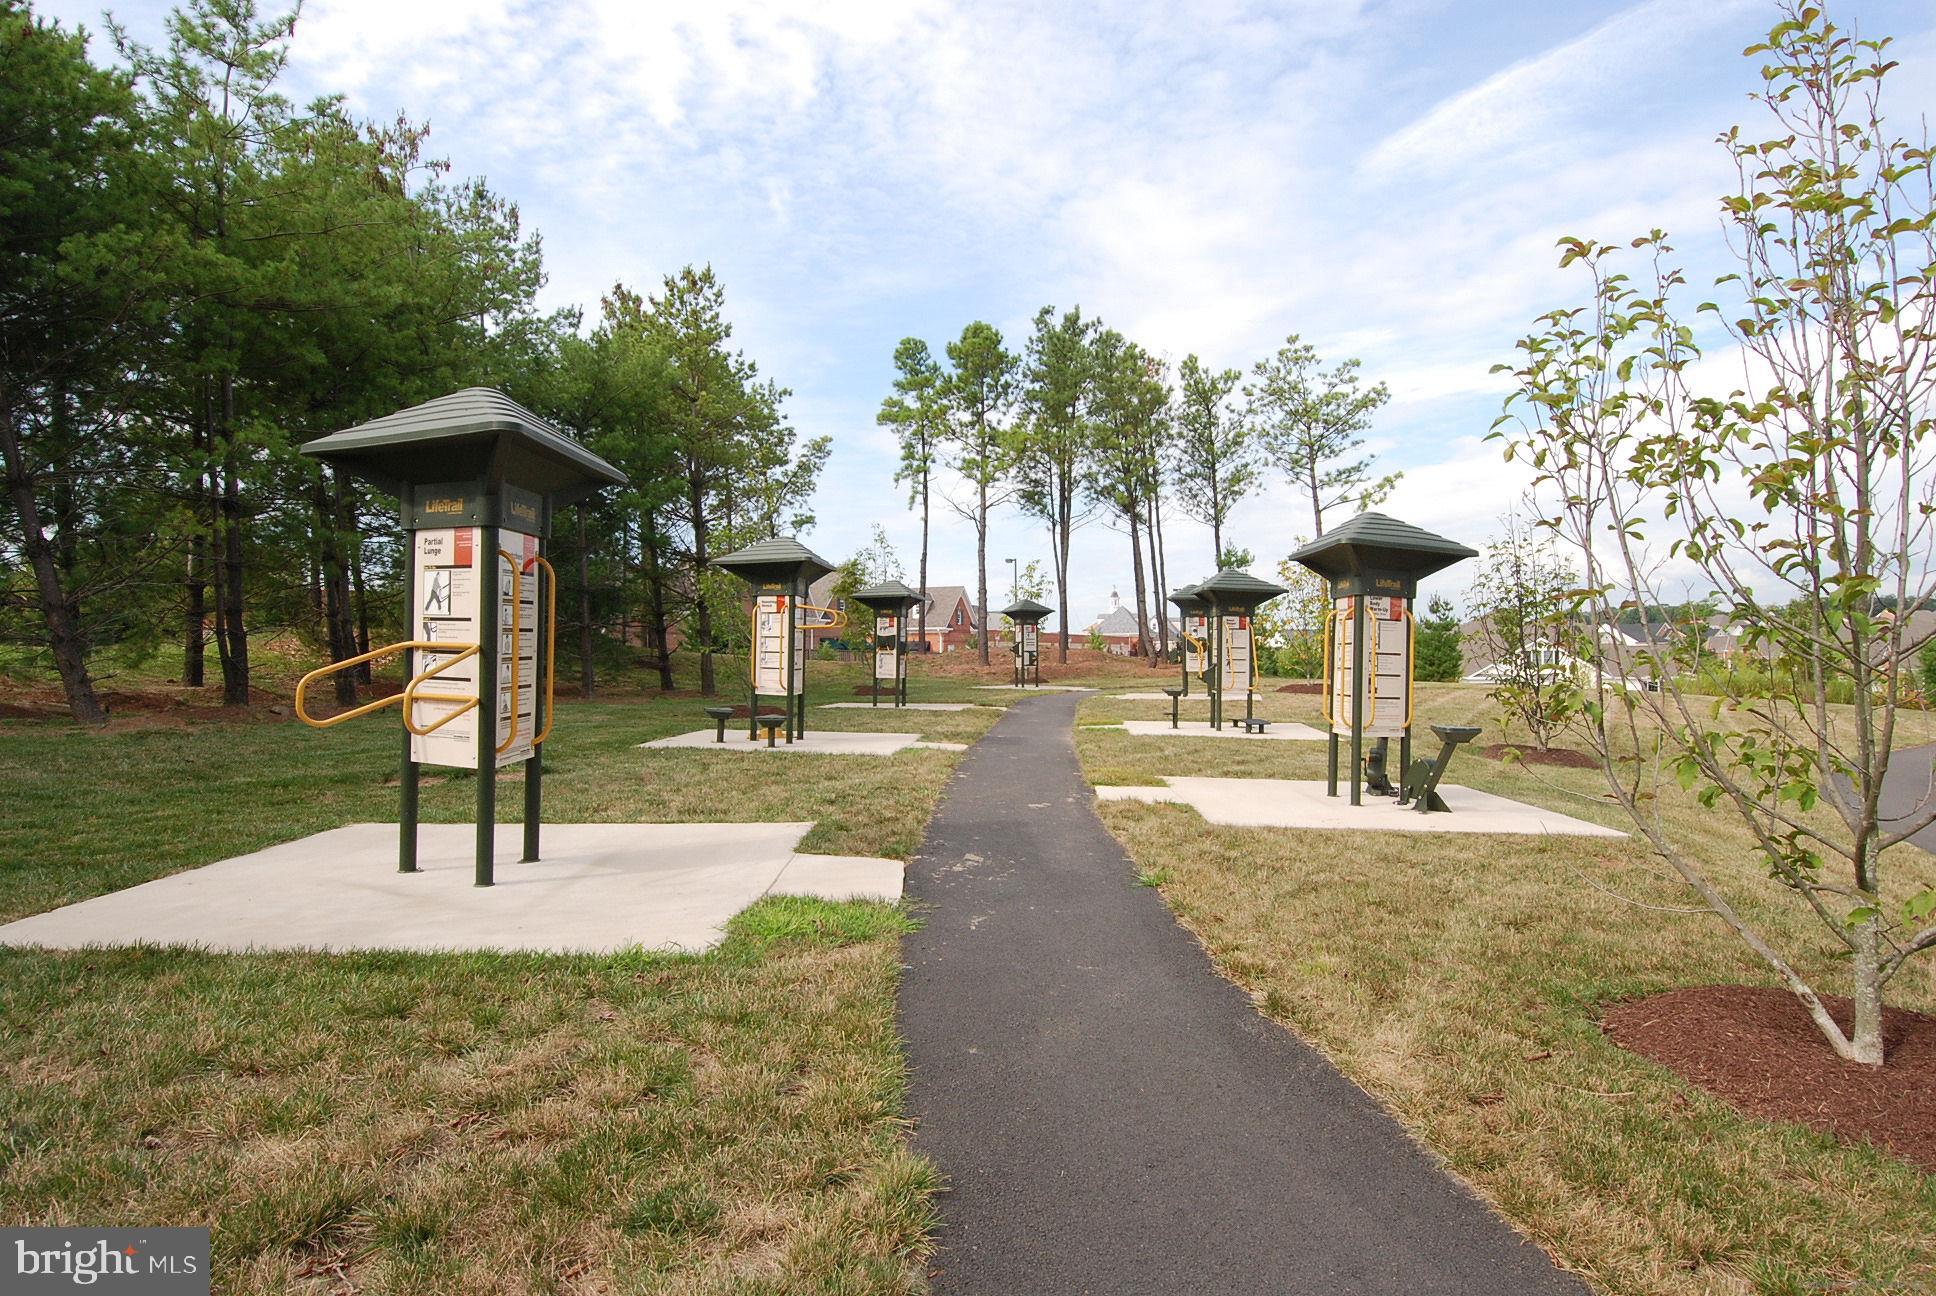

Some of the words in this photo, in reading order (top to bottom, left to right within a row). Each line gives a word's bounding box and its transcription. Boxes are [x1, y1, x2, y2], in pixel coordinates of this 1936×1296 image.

[425, 498, 463, 513] LifeTrail
[424, 537, 443, 546] Partial
[424, 548, 442, 556] Lunge
